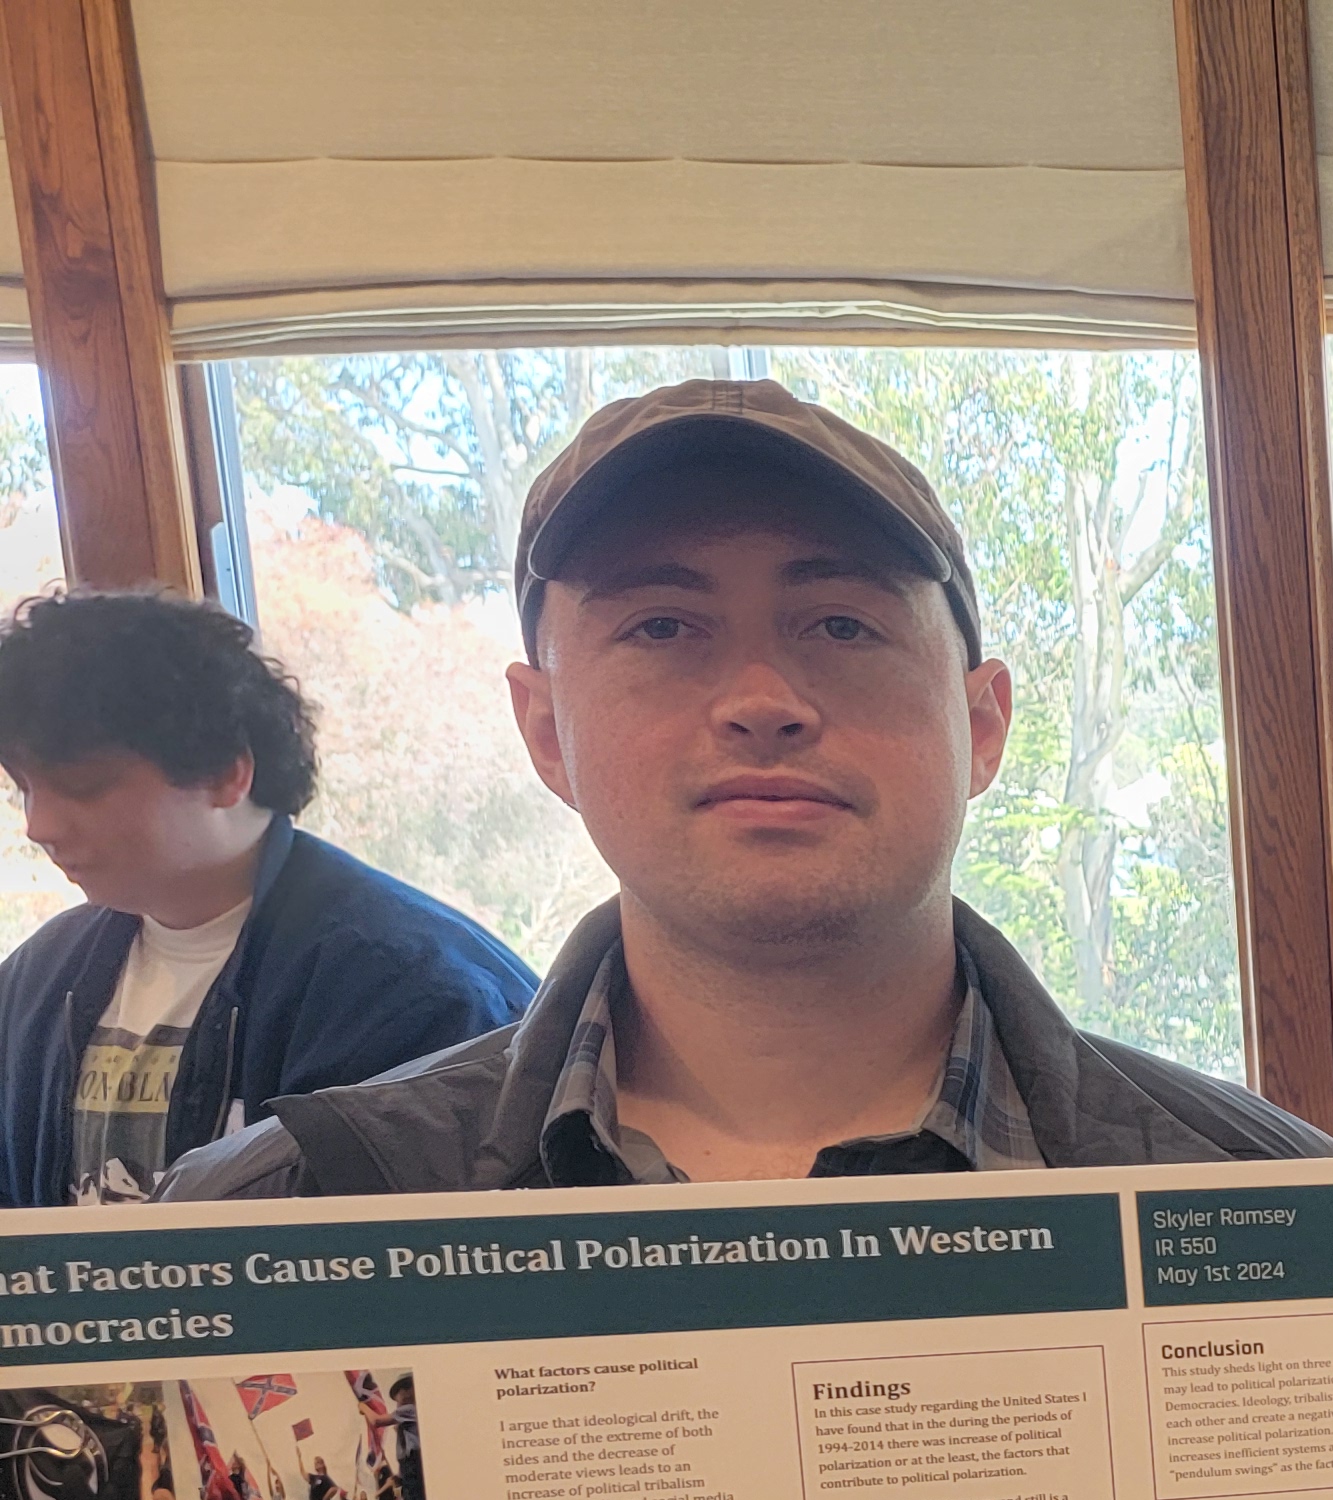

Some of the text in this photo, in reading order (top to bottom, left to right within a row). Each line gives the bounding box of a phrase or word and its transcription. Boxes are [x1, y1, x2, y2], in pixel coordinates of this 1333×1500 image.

[1153, 1208, 1296, 1230] Skyler Ramsey
[1155, 1236, 1216, 1255] IR 550
[65, 1261, 233, 1291] Factors
[245, 1253, 374, 1283] Cause
[386, 1240, 566, 1277] Political
[575, 1233, 830, 1268] Polarization
[839, 1229, 881, 1257] In
[888, 1226, 1054, 1254] Western
[1157, 1261, 1284, 1285] May 1st 2024
[1161, 1340, 1264, 1359] Conclusion
[494, 1358, 698, 1379] What factors cause political
[496, 1381, 595, 1399] polarization?
[812, 1381, 910, 1400] Findings
